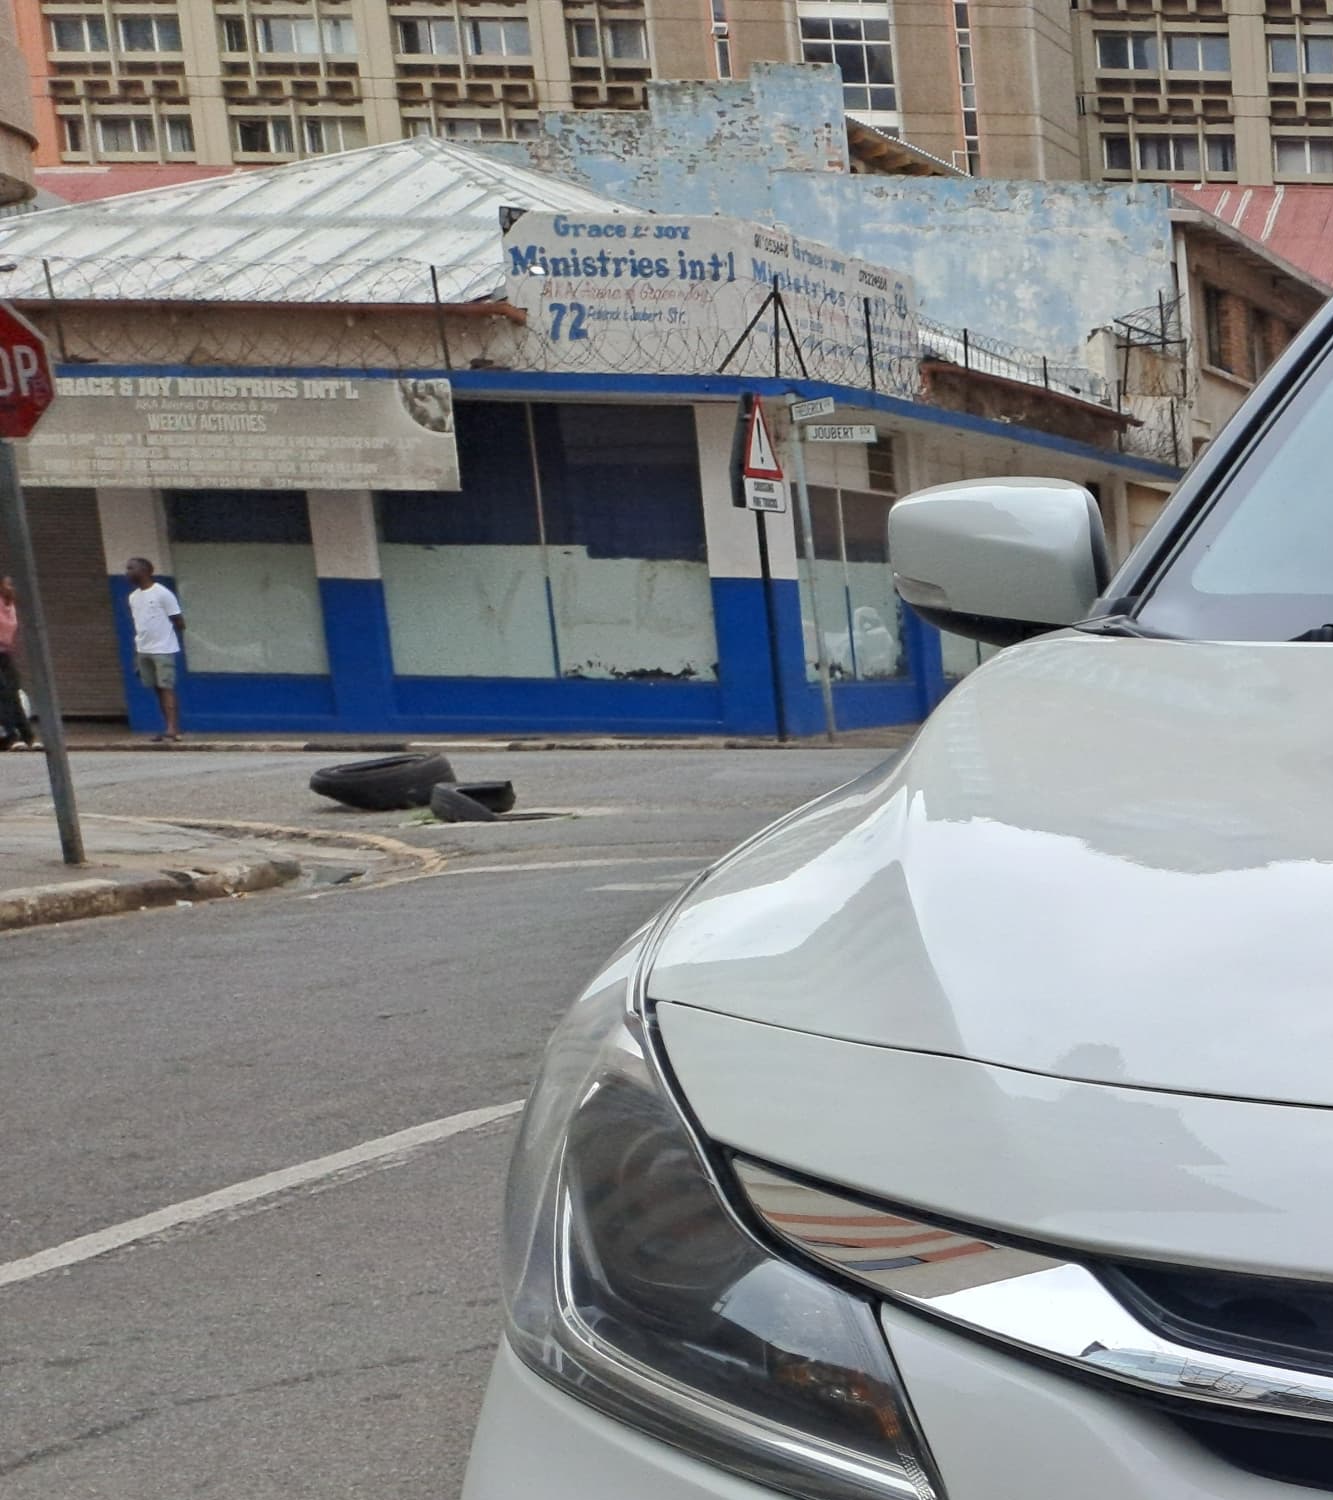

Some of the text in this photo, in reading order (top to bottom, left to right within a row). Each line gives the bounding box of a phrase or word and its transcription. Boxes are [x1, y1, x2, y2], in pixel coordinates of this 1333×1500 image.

[553, 214, 626, 239] Grace
[508, 245, 670, 279] Ministries
[549, 302, 589, 341] 72
[119, 377, 133, 397] &
[139, 377, 171, 397] JOY
[178, 377, 298, 398] MINISTRIES
[147, 413, 267, 433] WEEKLY ACTIVITIES
[812, 426, 855, 440] JOUBERT
